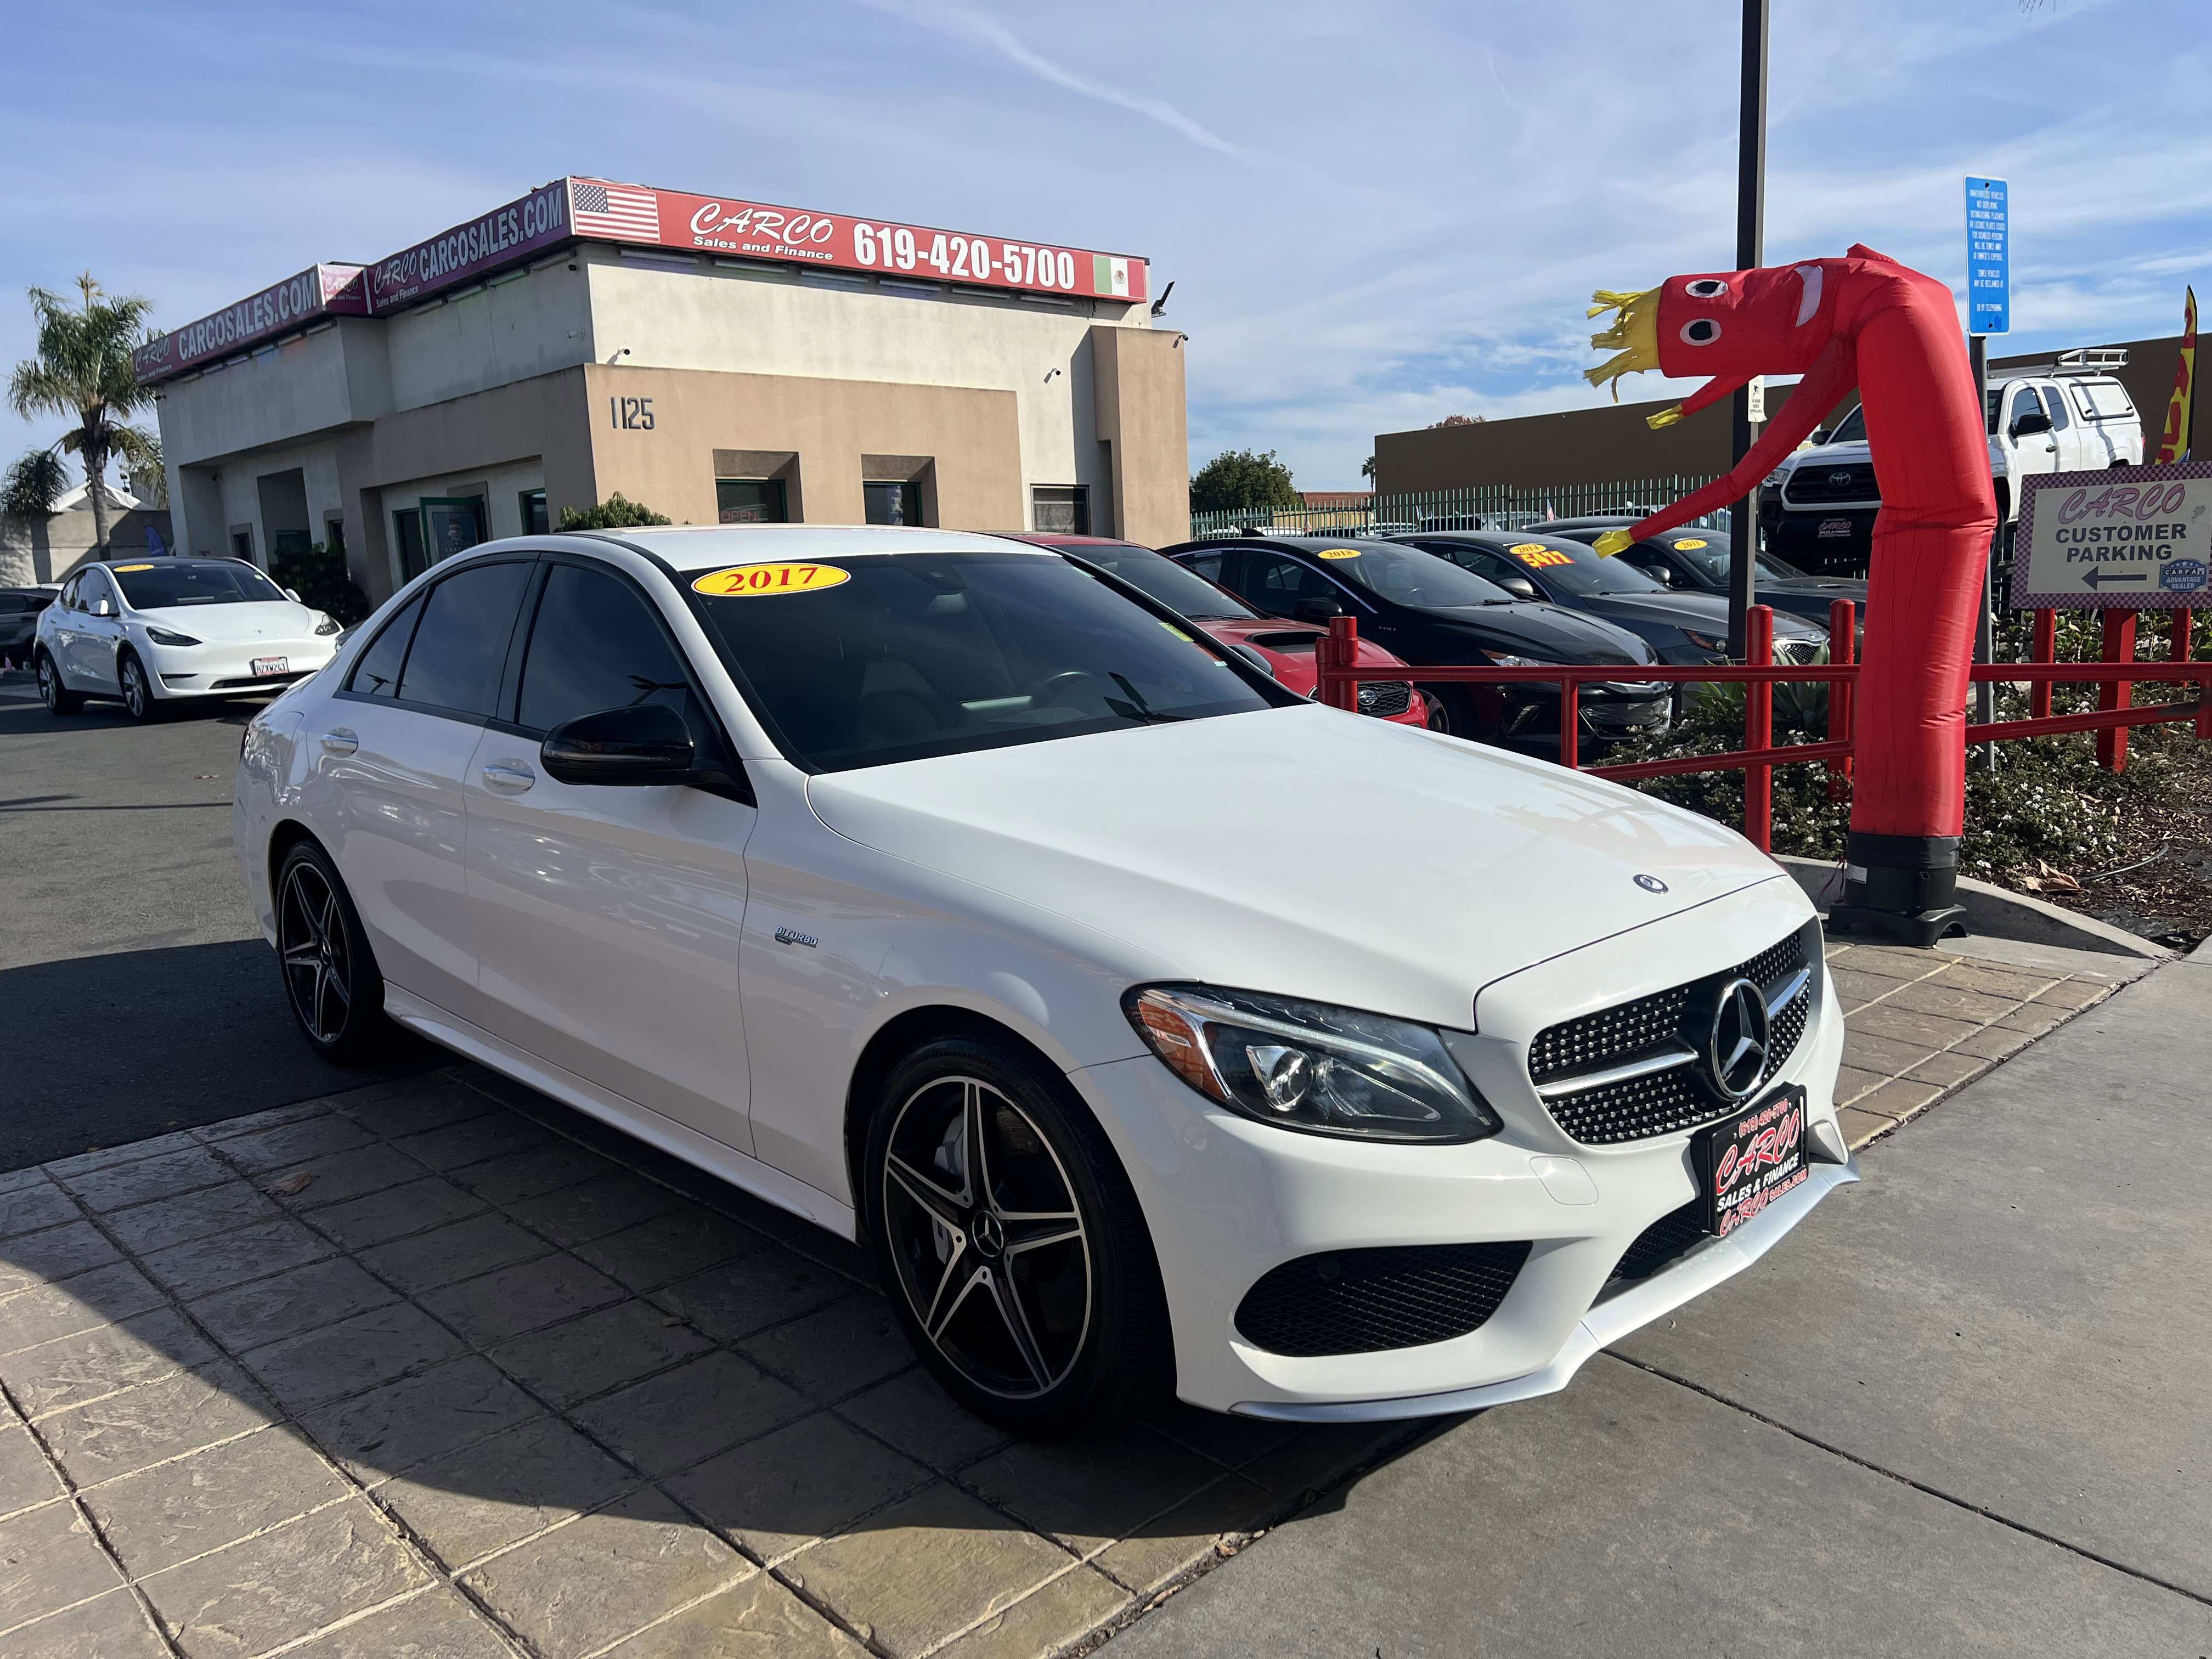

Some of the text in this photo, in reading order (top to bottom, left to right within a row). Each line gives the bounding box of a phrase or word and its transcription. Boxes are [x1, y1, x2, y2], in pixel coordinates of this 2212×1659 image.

[420, 187, 562, 282] CARCOSALES.COM
[690, 202, 833, 245] CARCO
[693, 236, 833, 261] Sales and Finance
[853, 222, 1075, 290] 619-420-5700
[325, 276, 358, 292] CARCO
[374, 251, 417, 295] CARCO
[399, 285, 419, 300] Finance
[179, 272, 317, 360] CARCOSALES.COM
[610, 397, 654, 430] 1125
[720, 510, 758, 521] OPEN
[2058, 483, 2186, 524] CARCO
[2056, 523, 2187, 544] CUSTOMER
[1326, 550, 1353, 558] 2018
[1516, 545, 1539, 553] 2014
[2067, 544, 2172, 562] PARKING
[724, 567, 819, 592] 2017
[775, 926, 818, 945] BITURBO
[1739, 1098, 1788, 1138] (619) 420-5700
[1716, 1108, 1799, 1195] CARCO
[1717, 1152, 1799, 1212] SALES & FINANCE
